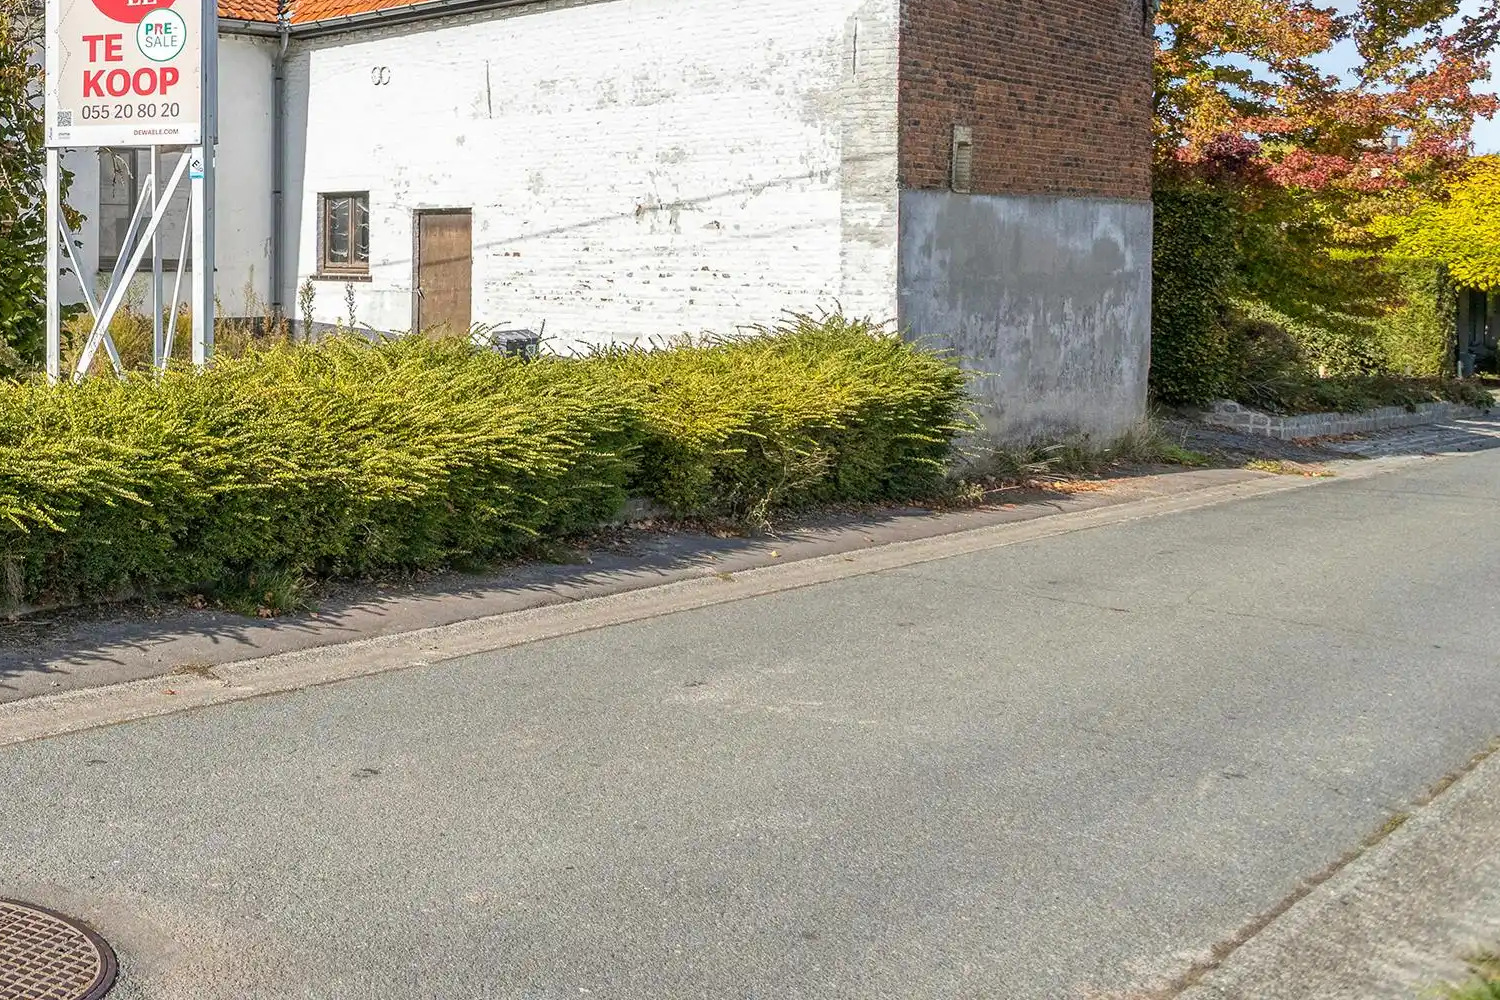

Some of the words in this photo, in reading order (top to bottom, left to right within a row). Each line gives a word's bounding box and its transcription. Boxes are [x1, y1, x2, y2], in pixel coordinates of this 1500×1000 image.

[145, 23, 178, 36] PRE-
[82, 34, 124, 63] TE
[145, 36, 178, 48] SALE
[83, 67, 180, 98] KOOP
[82, 105, 110, 120] 055
[114, 104, 133, 119] 20
[137, 103, 157, 118] 80
[161, 102, 180, 118] 20
[133, 128, 179, 136] DEWAELE.COM
